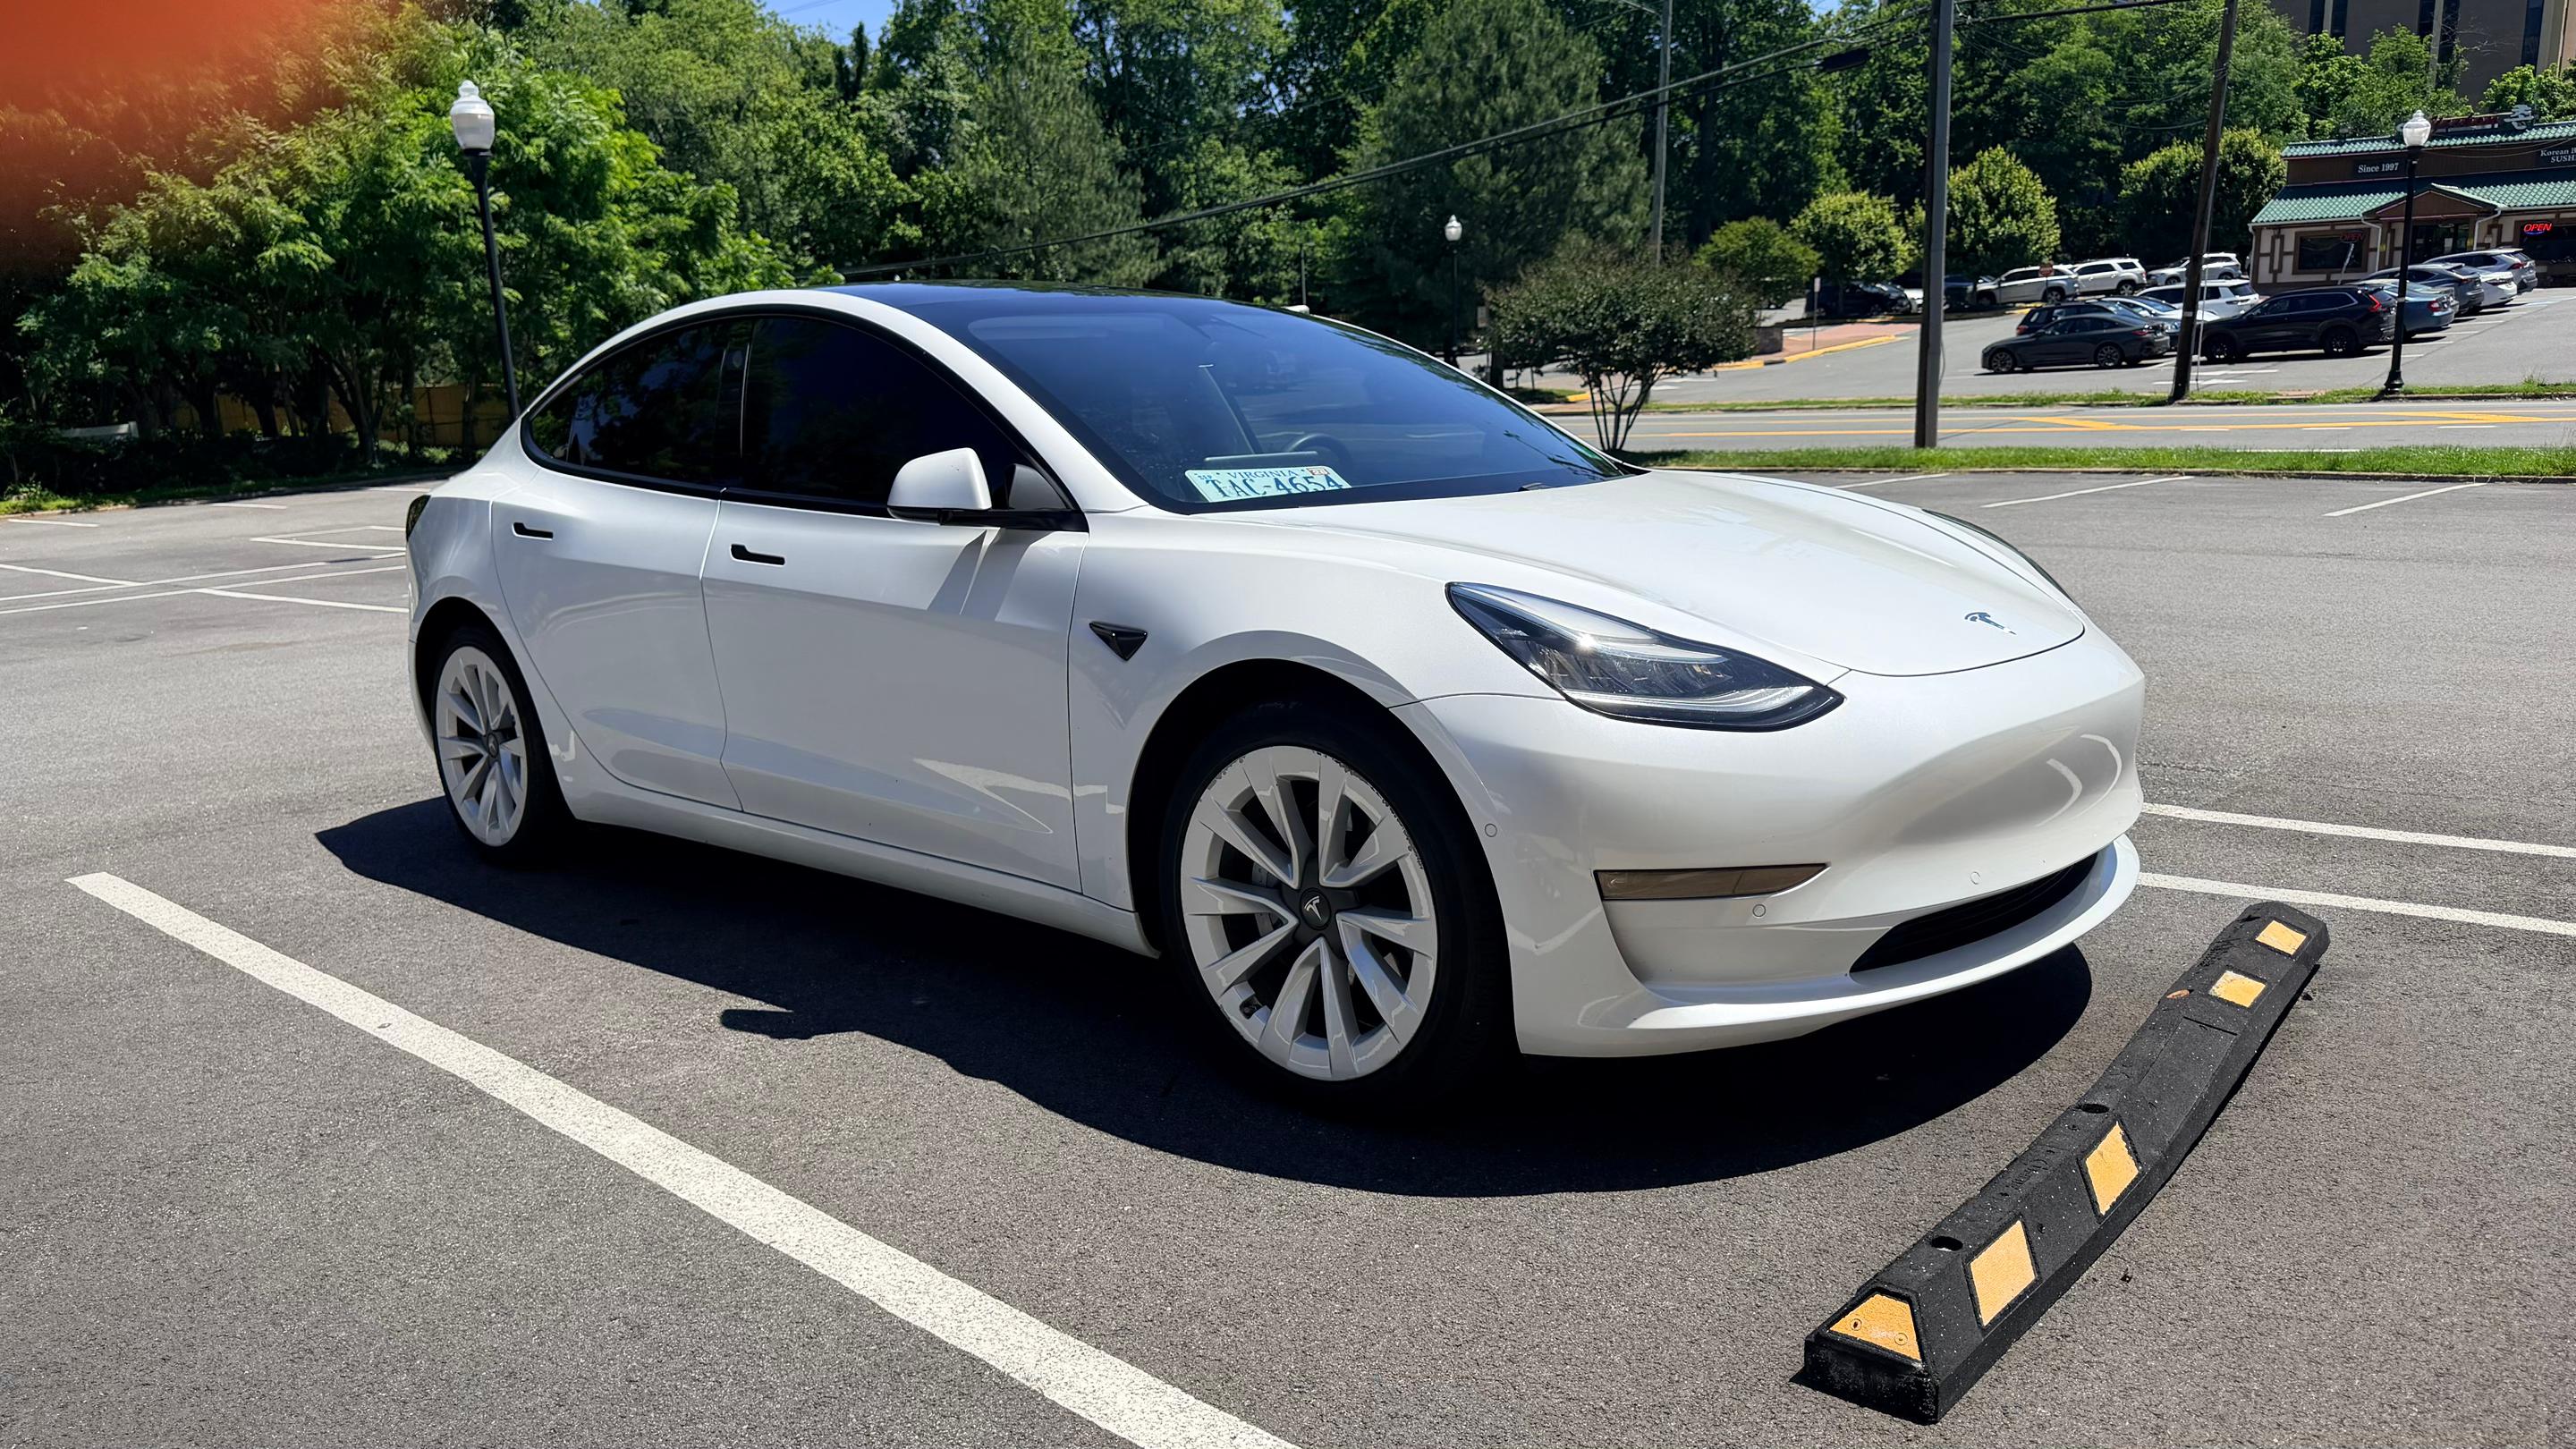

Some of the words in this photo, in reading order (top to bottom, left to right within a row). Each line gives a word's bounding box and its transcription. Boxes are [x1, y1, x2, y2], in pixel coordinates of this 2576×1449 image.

[2358, 165, 2380, 173] Since
[2381, 162, 2399, 172] 1997
[2523, 223, 2553, 233] OPEN
[1227, 470, 1299, 479] VIRGINIA
[1205, 474, 1343, 498] TAC-4654
